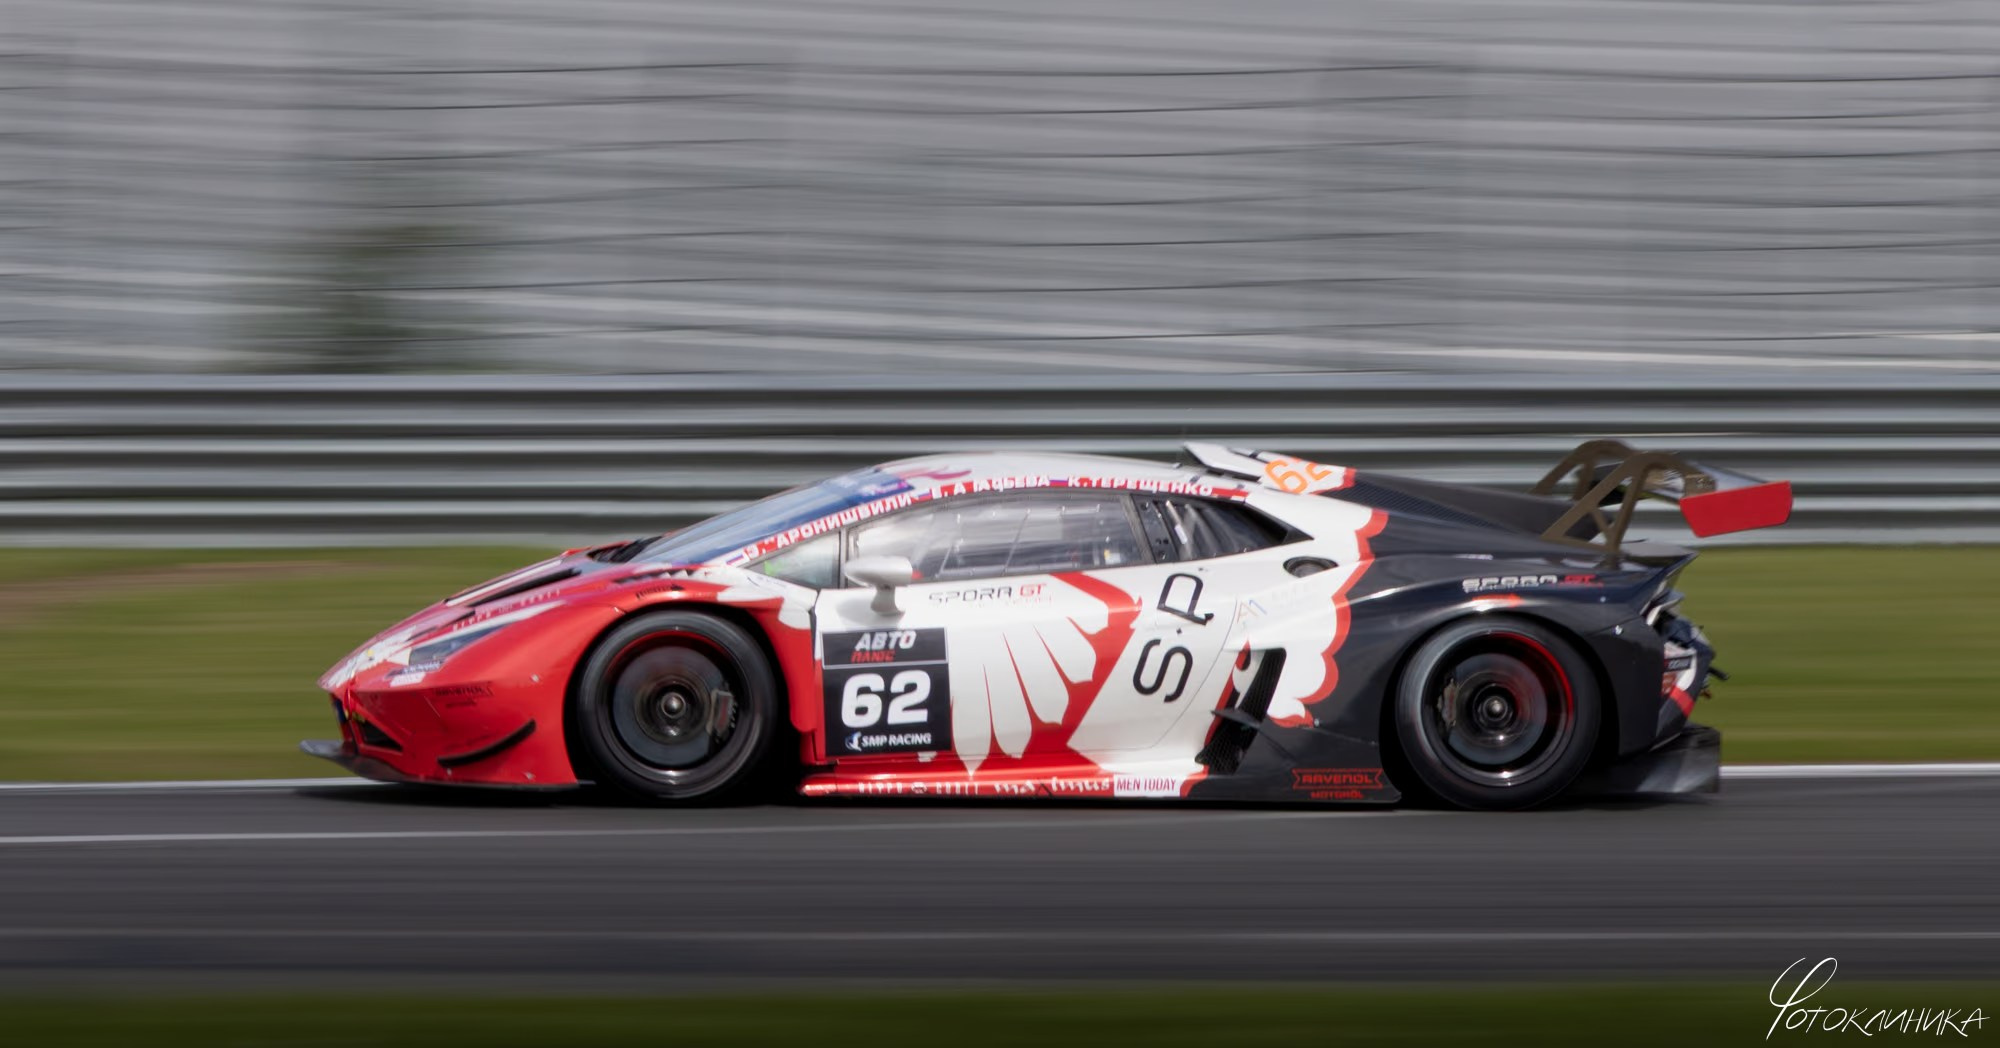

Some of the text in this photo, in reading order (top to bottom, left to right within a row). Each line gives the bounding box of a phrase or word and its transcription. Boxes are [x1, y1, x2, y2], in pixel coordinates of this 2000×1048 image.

[928, 585, 1013, 604] SPORA
[854, 630, 917, 652] АВТО
[841, 669, 931, 728] 62
[861, 732, 932, 748] SMP RACING
[1116, 777, 1141, 792] MEN
[1144, 777, 1176, 792] TODAY
[1302, 773, 1373, 785] RAVENOL
